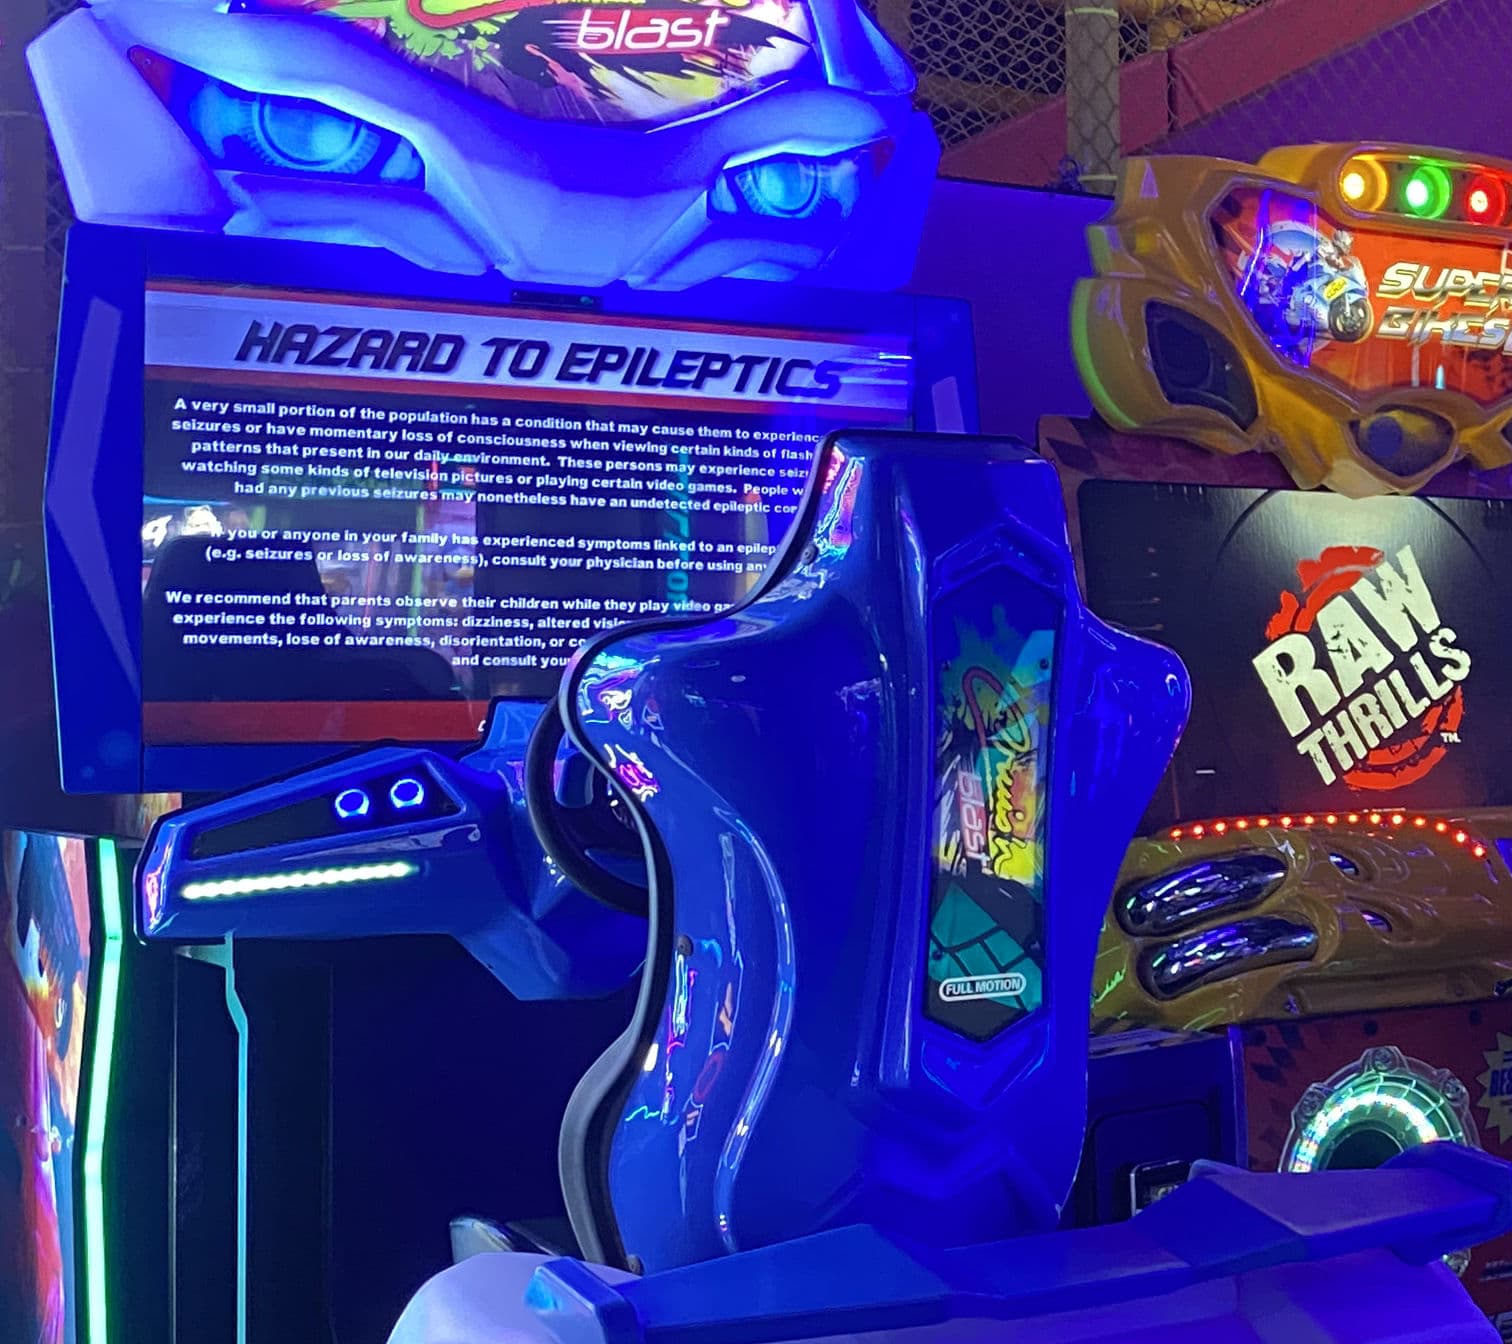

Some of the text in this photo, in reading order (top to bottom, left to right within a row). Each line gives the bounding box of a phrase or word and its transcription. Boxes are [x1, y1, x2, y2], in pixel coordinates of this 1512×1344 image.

[574, 8, 728, 51] blast
[235, 319, 845, 399] HAZARD TO EPILEPTICS
[172, 418, 813, 459] seizures or have momentary loss of consciousness when viewing certain kinds of flash
[174, 397, 817, 446] A very small portion of the population has a condition that may cause them to experienc
[182, 459, 257, 478] watching
[261, 464, 303, 476] some
[308, 463, 349, 478] kinds
[354, 465, 370, 479] of
[374, 466, 448, 482] television
[452, 469, 513, 488] pictures
[517, 474, 533, 485] or
[536, 472, 588, 491] playing
[592, 475, 643, 490] certain
[646, 477, 685, 492] video
[688, 481, 737, 497] games.
[744, 481, 789, 500] People
[192, 439, 261, 458] patterns
[266, 442, 298, 456] that
[302, 443, 363, 462] present
[367, 446, 380, 459] in
[384, 449, 410, 460] our
[414, 447, 449, 465] daily
[453, 449, 549, 466] environment.
[557, 454, 602, 469] These
[605, 458, 662, 475] persons
[665, 461, 695, 477] may
[699, 461, 775, 481] experience
[205, 546, 241, 563] (e.g.
[246, 546, 312, 561] seizures
[317, 550, 333, 561] or
[338, 548, 370, 562] loss
[374, 549, 390, 562] of
[395, 552, 489, 568] awareness),
[492, 552, 546, 566] consult
[550, 556, 583, 571] your
[586, 554, 654, 573] physician
[657, 557, 704, 571] before
[707, 558, 743, 576] using
[228, 529, 257, 543] you
[261, 529, 278, 540] or
[282, 530, 340, 545] anyone
[344, 529, 358, 542] in
[362, 532, 396, 547] your
[402, 530, 447, 548] family
[452, 532, 478, 545] has
[483, 532, 574, 551] experienced
[578, 535, 650, 554] symptoms
[654, 537, 695, 551] linked
[699, 539, 713, 552] to
[717, 542, 733, 553] an
[737, 540, 775, 558] epilep
[166, 589, 192, 603] We
[196, 590, 291, 604] recommend
[295, 592, 327, 605] that
[331, 592, 391, 610] parents
[396, 593, 457, 607] observe
[462, 594, 496, 608] their
[500, 595, 558, 609] children
[562, 596, 601, 610] while
[604, 597, 636, 614] they
[639, 597, 669, 614] play
[673, 598, 711, 612] video
[173, 611, 265, 628] experience
[269, 612, 295, 625] the
[300, 612, 371, 629] following
[376, 613, 458, 630] symptoms:
[462, 614, 534, 631] dizziness,
[537, 615, 590, 628] altered
[183, 631, 283, 648] movements,
[286, 632, 320, 645] lose
[324, 632, 341, 645] of
[345, 635, 435, 649] awareness,
[439, 633, 546, 650] disorientation,
[549, 636, 565, 647] or
[452, 653, 479, 666] and
[483, 653, 537, 666] consult
[1252, 545, 1440, 736] RAW
[1297, 627, 1472, 786] THRILLS
[945, 976, 1021, 997] FULL MOTION
